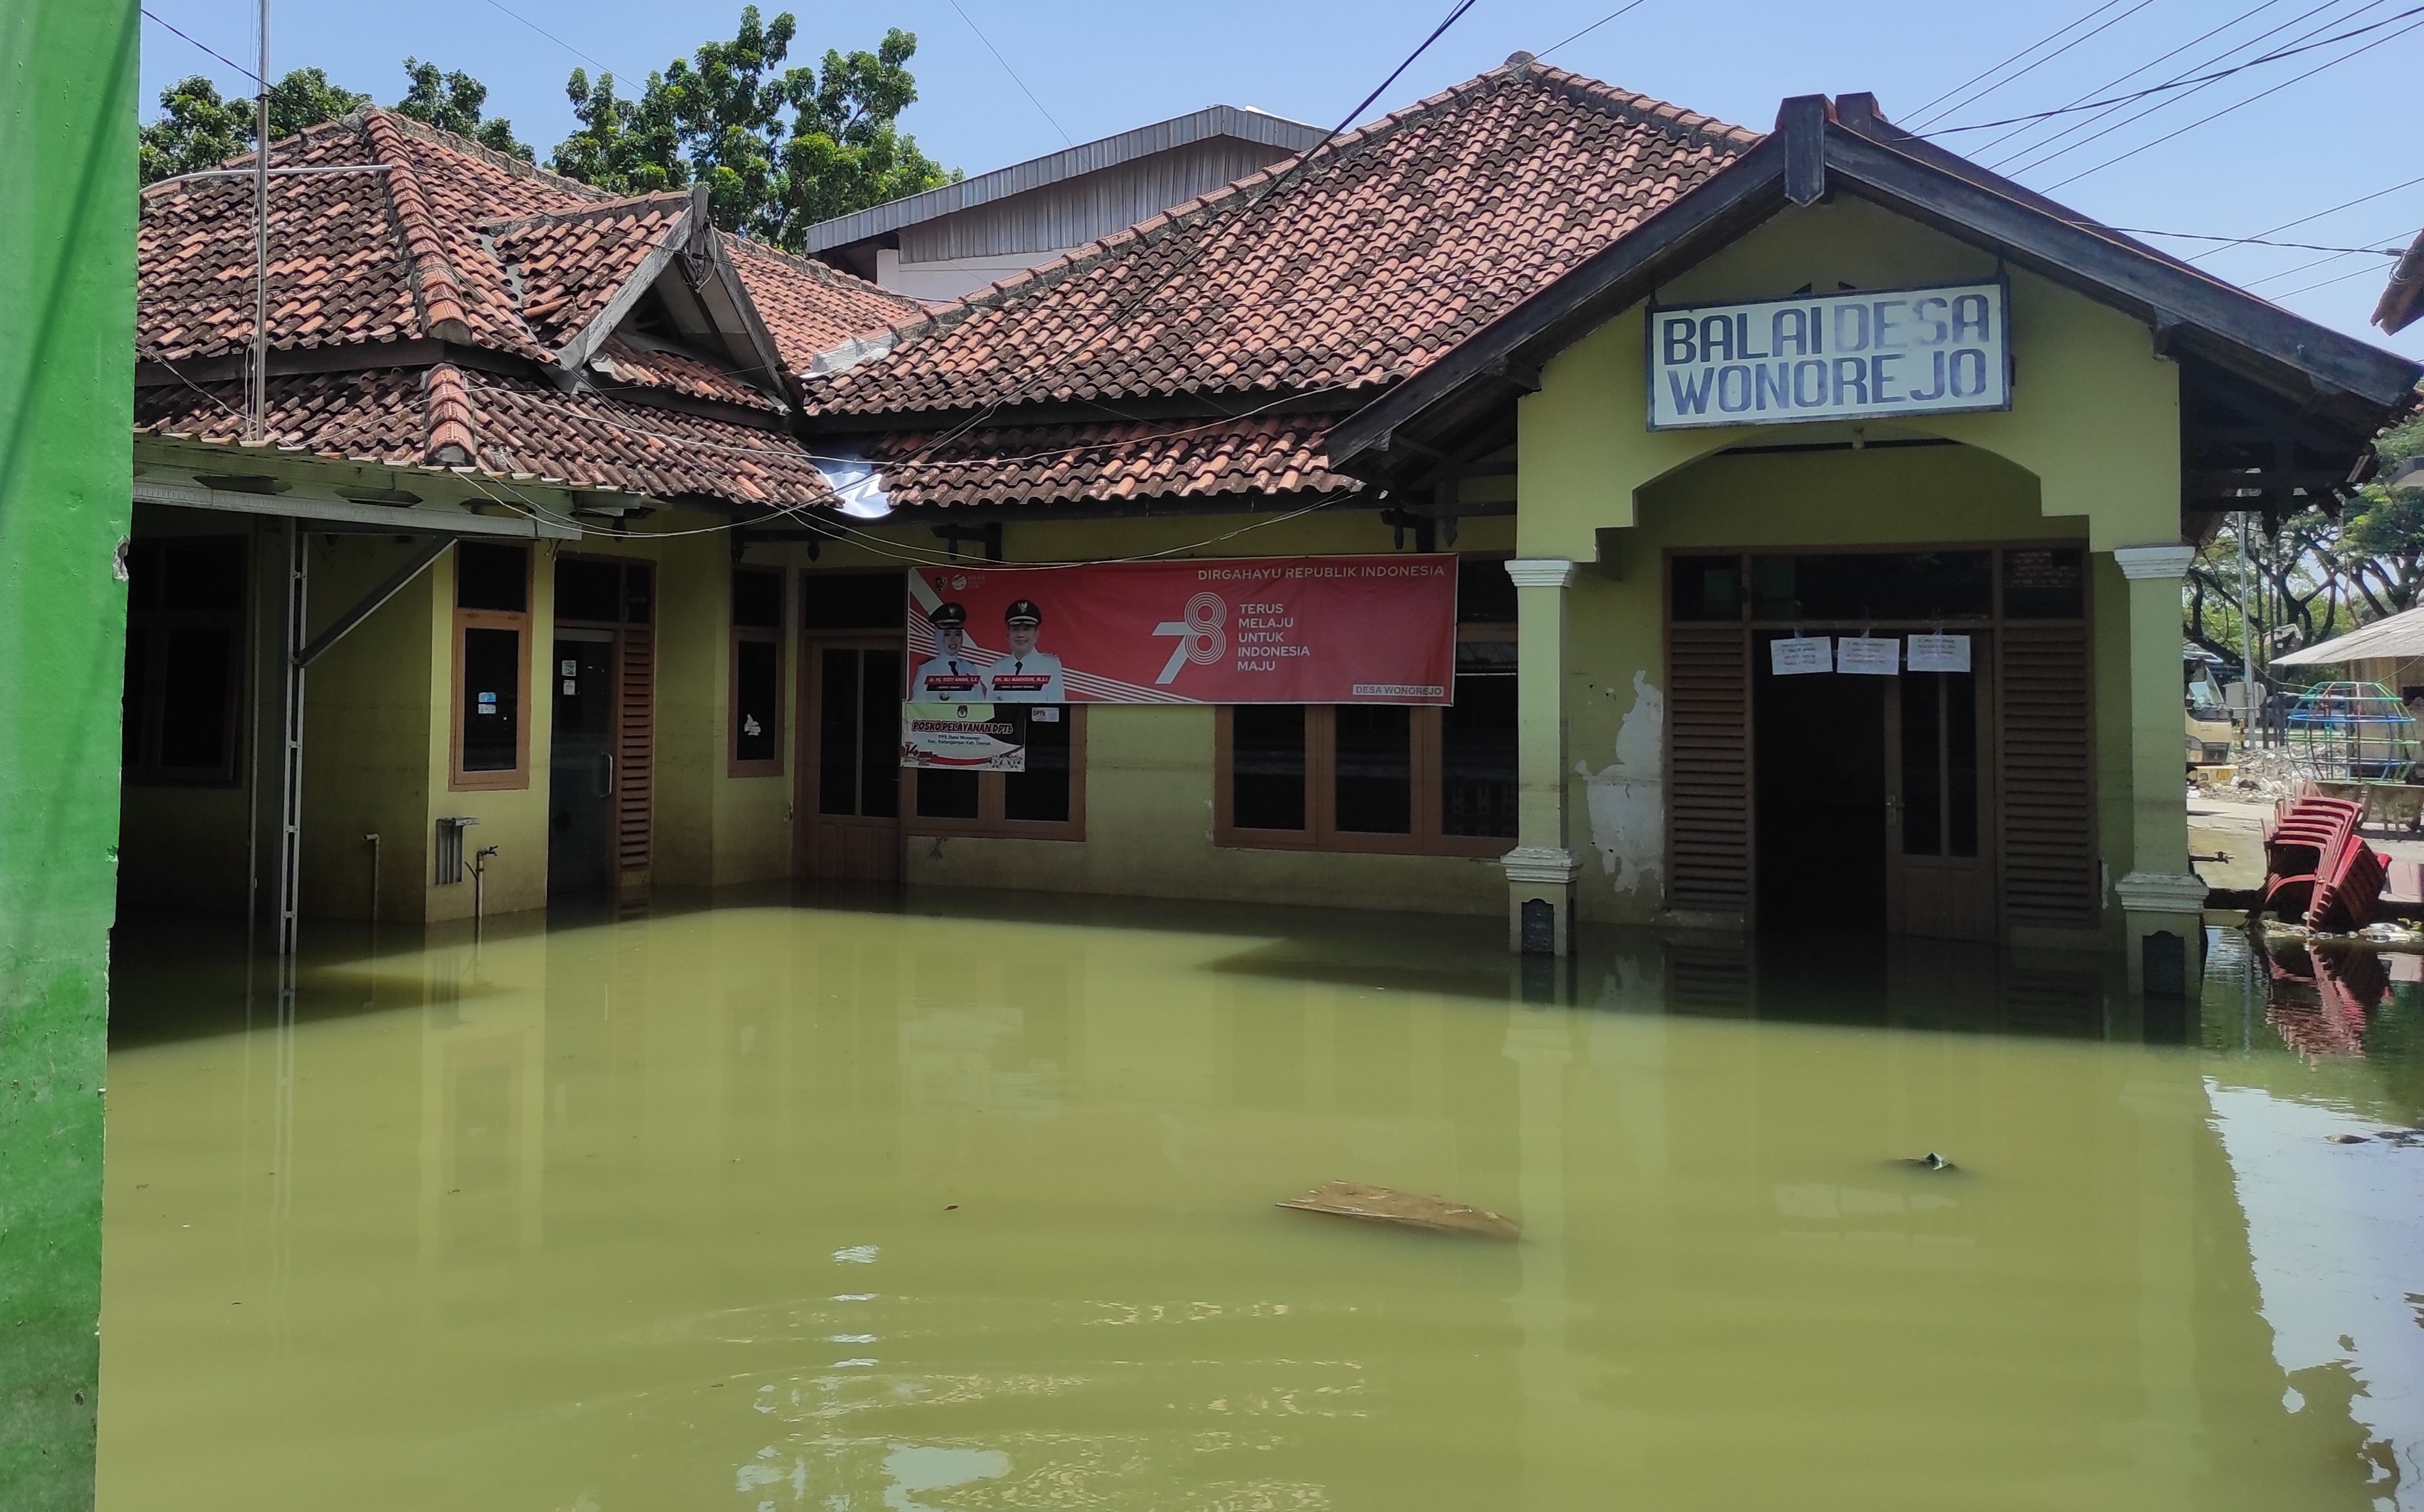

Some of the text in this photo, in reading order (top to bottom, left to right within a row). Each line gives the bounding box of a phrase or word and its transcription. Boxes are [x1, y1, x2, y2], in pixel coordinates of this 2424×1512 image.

[1664, 294, 1990, 365] BALAI DESA
[1667, 348, 1987, 415] WONOREJO
[1198, 565, 1444, 580] DIRGAHAYU REPUBLIK INDONESIA
[1240, 603, 1284, 614] TERUS
[1238, 618, 1294, 628] MELAJU
[1238, 632, 1284, 643] UNTUK
[1238, 646, 1310, 657] INDONESIA
[1237, 661, 1276, 671] MAJU
[913, 721, 1014, 734] POSKO PELAYANAN DPTb
